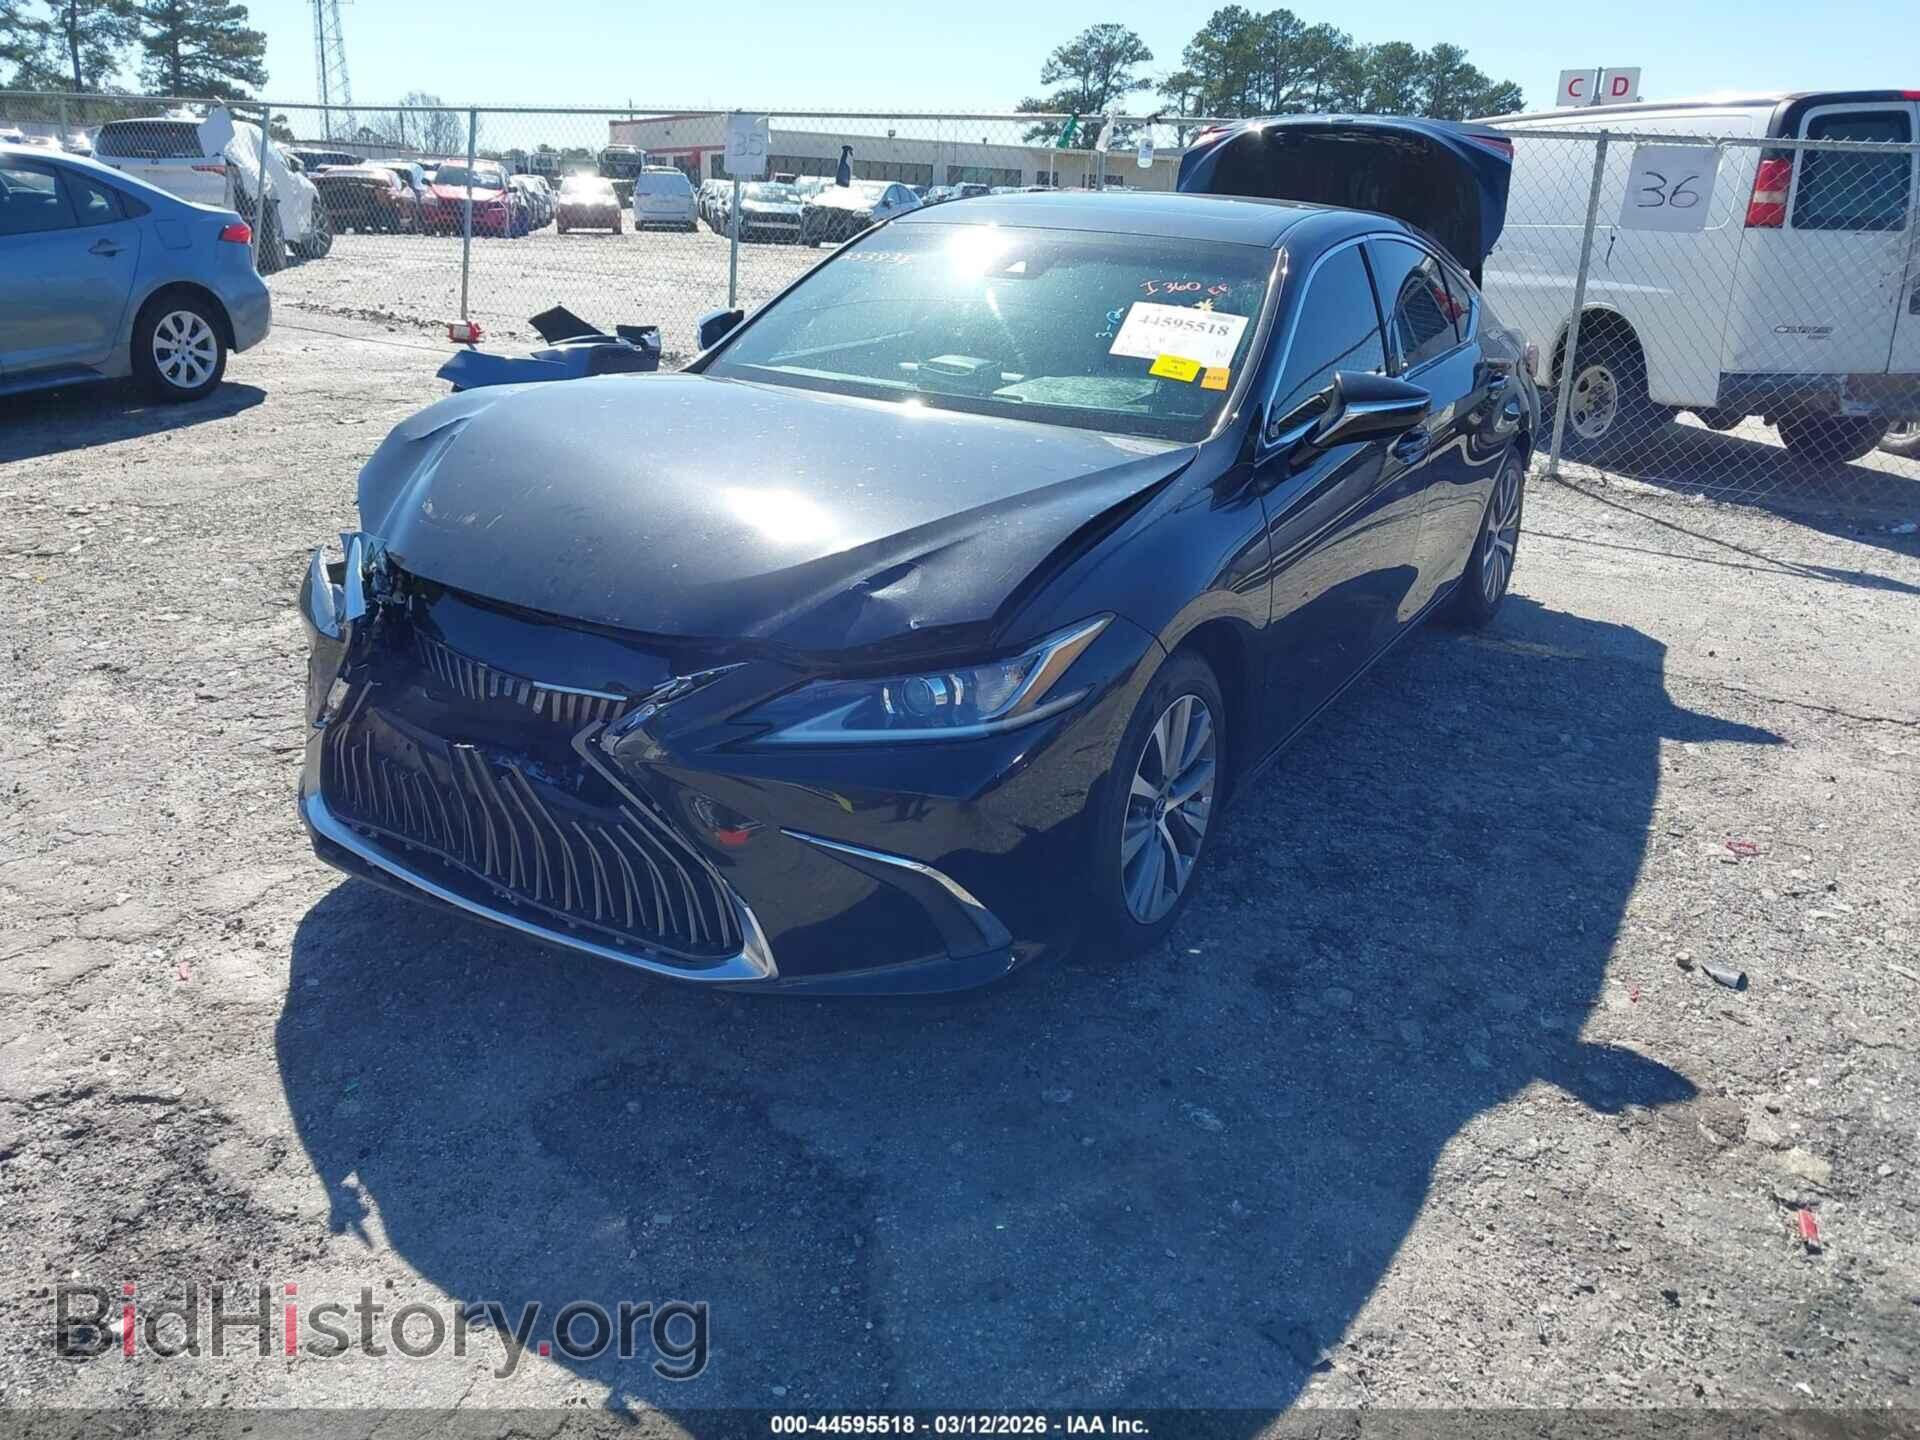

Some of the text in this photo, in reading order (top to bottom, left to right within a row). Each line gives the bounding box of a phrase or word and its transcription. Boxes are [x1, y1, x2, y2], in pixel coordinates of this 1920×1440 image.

[1567, 78, 1585, 97] C
[1611, 76, 1629, 97] D
[1637, 170, 1700, 209] 36
[1137, 314, 1230, 337] 44595518
